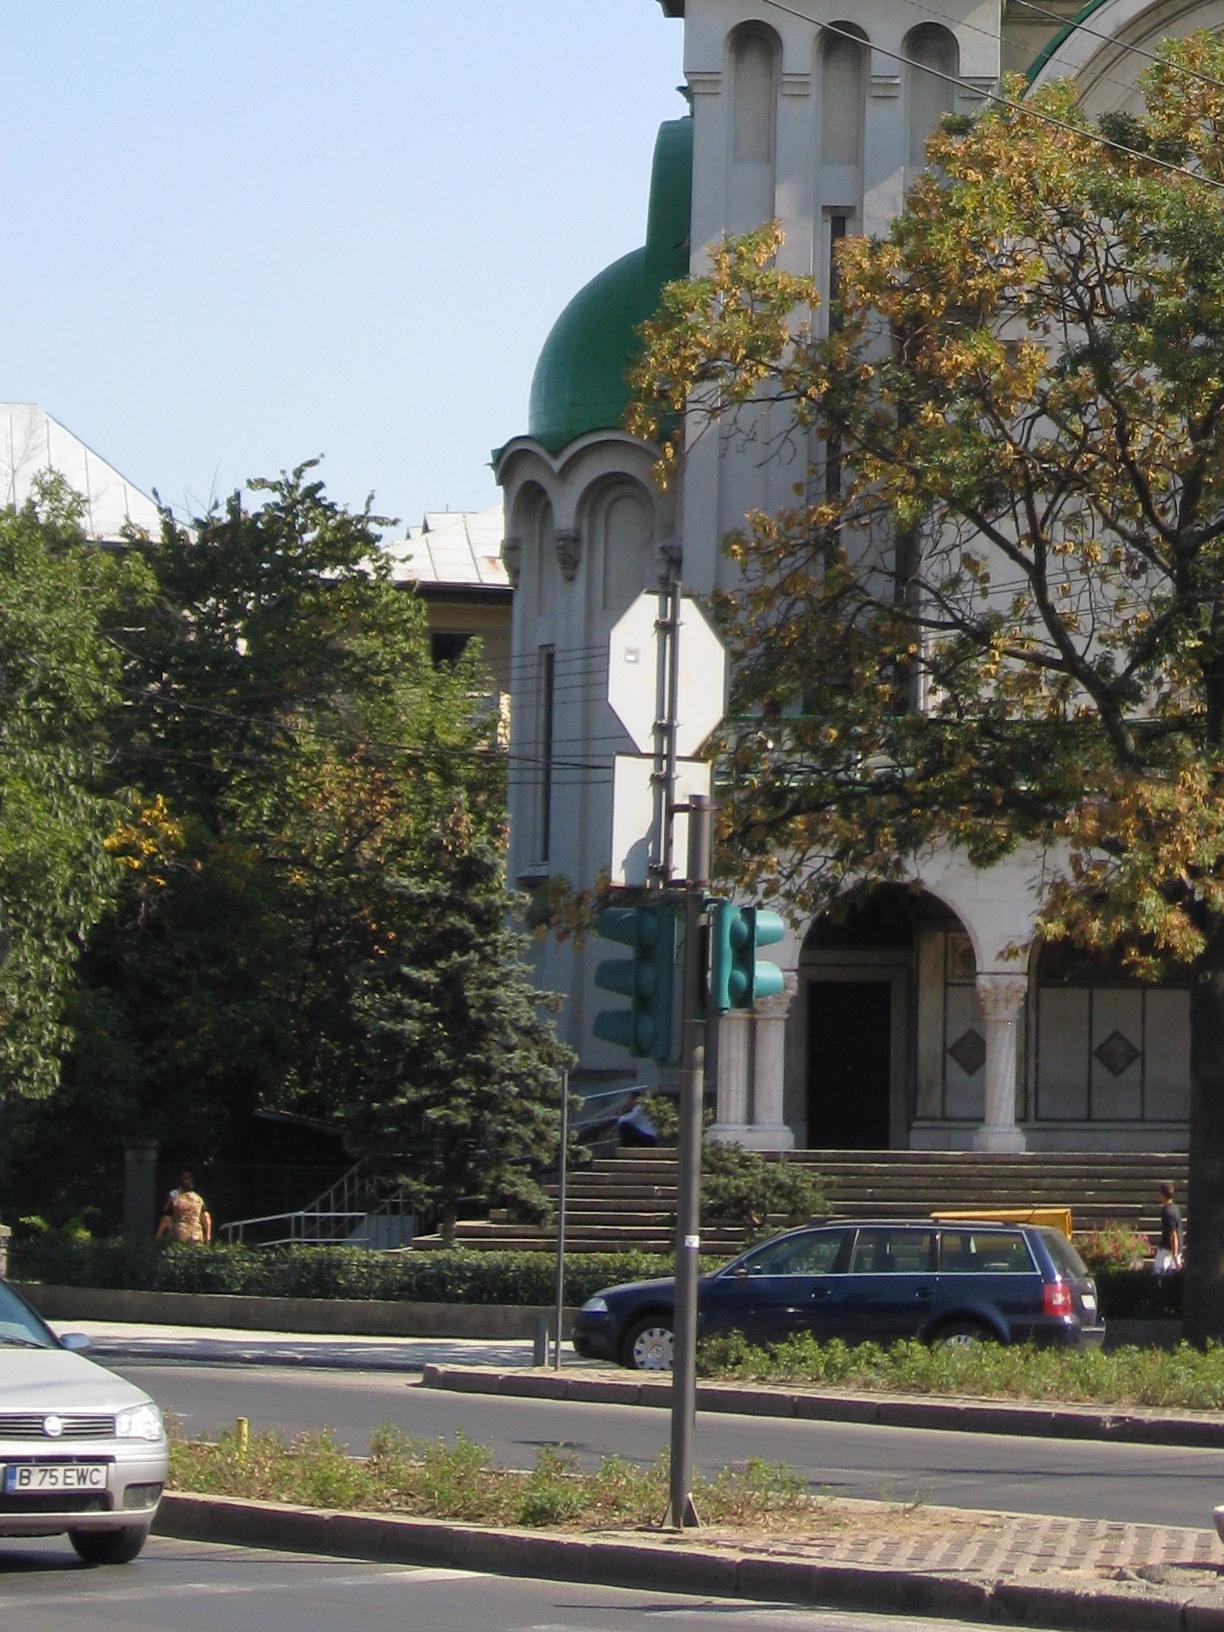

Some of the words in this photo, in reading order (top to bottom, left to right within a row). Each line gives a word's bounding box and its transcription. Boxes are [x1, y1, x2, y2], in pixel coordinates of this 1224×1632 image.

[18, 1468, 32, 1487] B
[38, 1468, 59, 1486] 75
[62, 1467, 101, 1486] EWC
